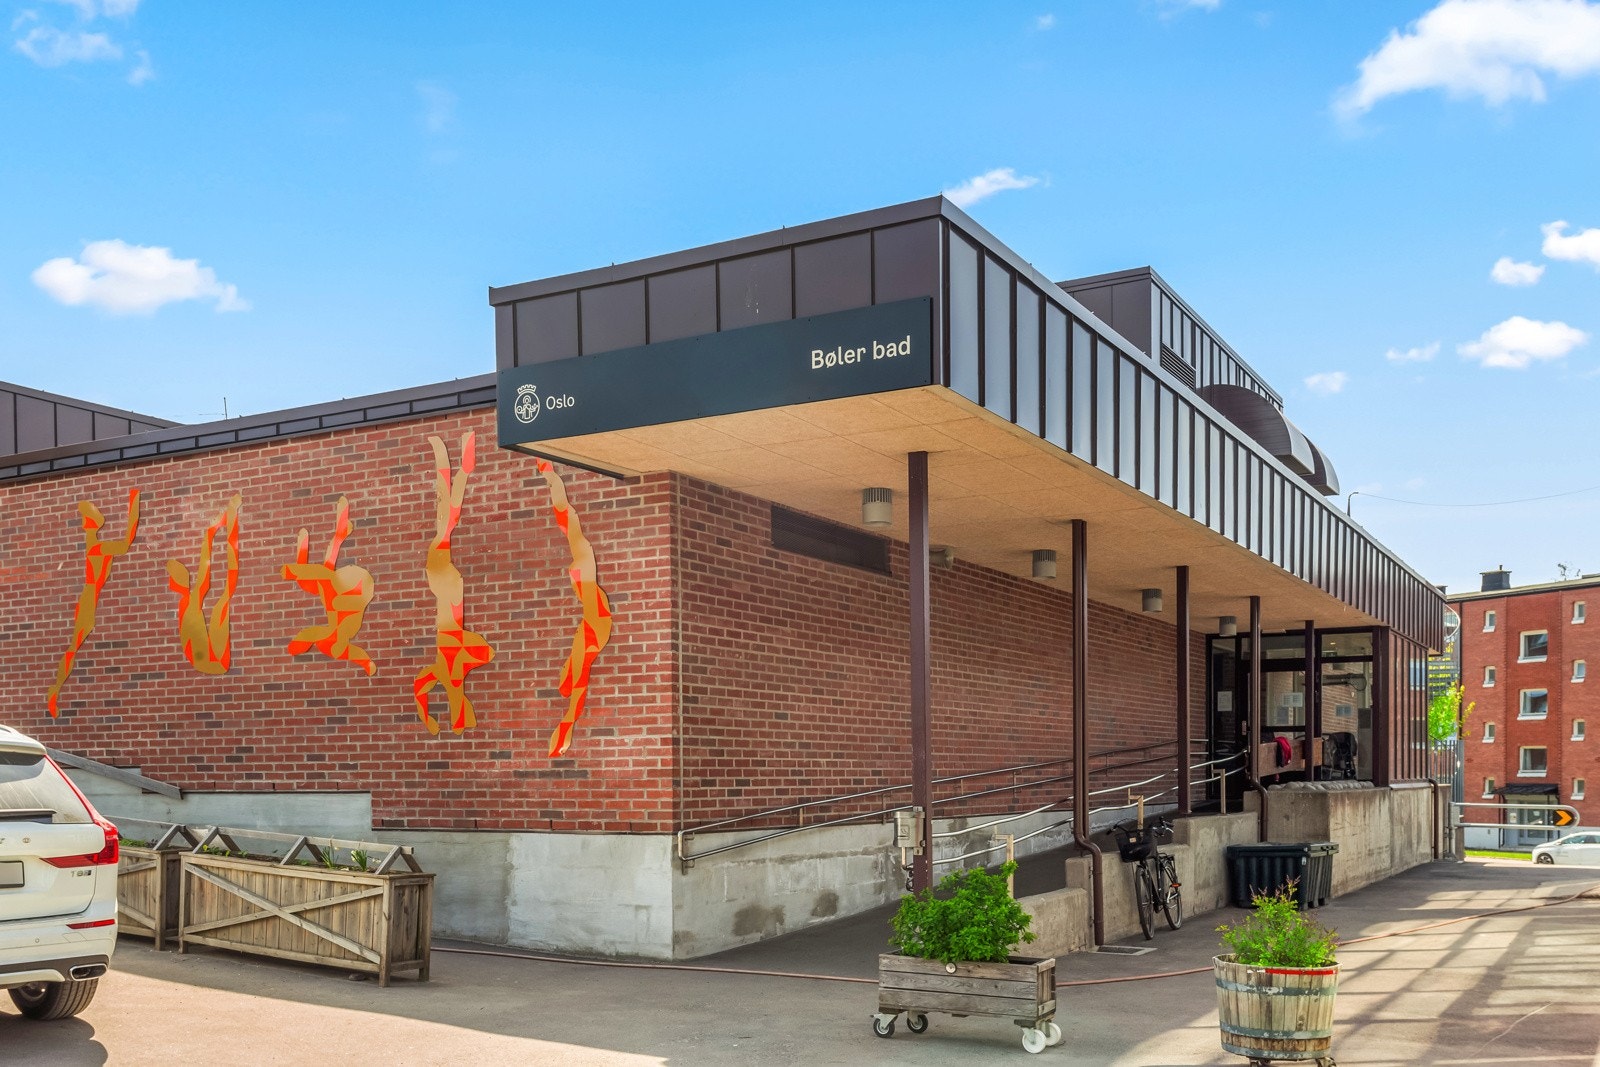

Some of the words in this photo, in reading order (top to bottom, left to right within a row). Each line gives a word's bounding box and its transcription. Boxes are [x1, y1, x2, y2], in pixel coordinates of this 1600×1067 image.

[811, 346, 867, 370] Bøler
[872, 334, 911, 360] bad
[545, 393, 575, 410] Oslo
